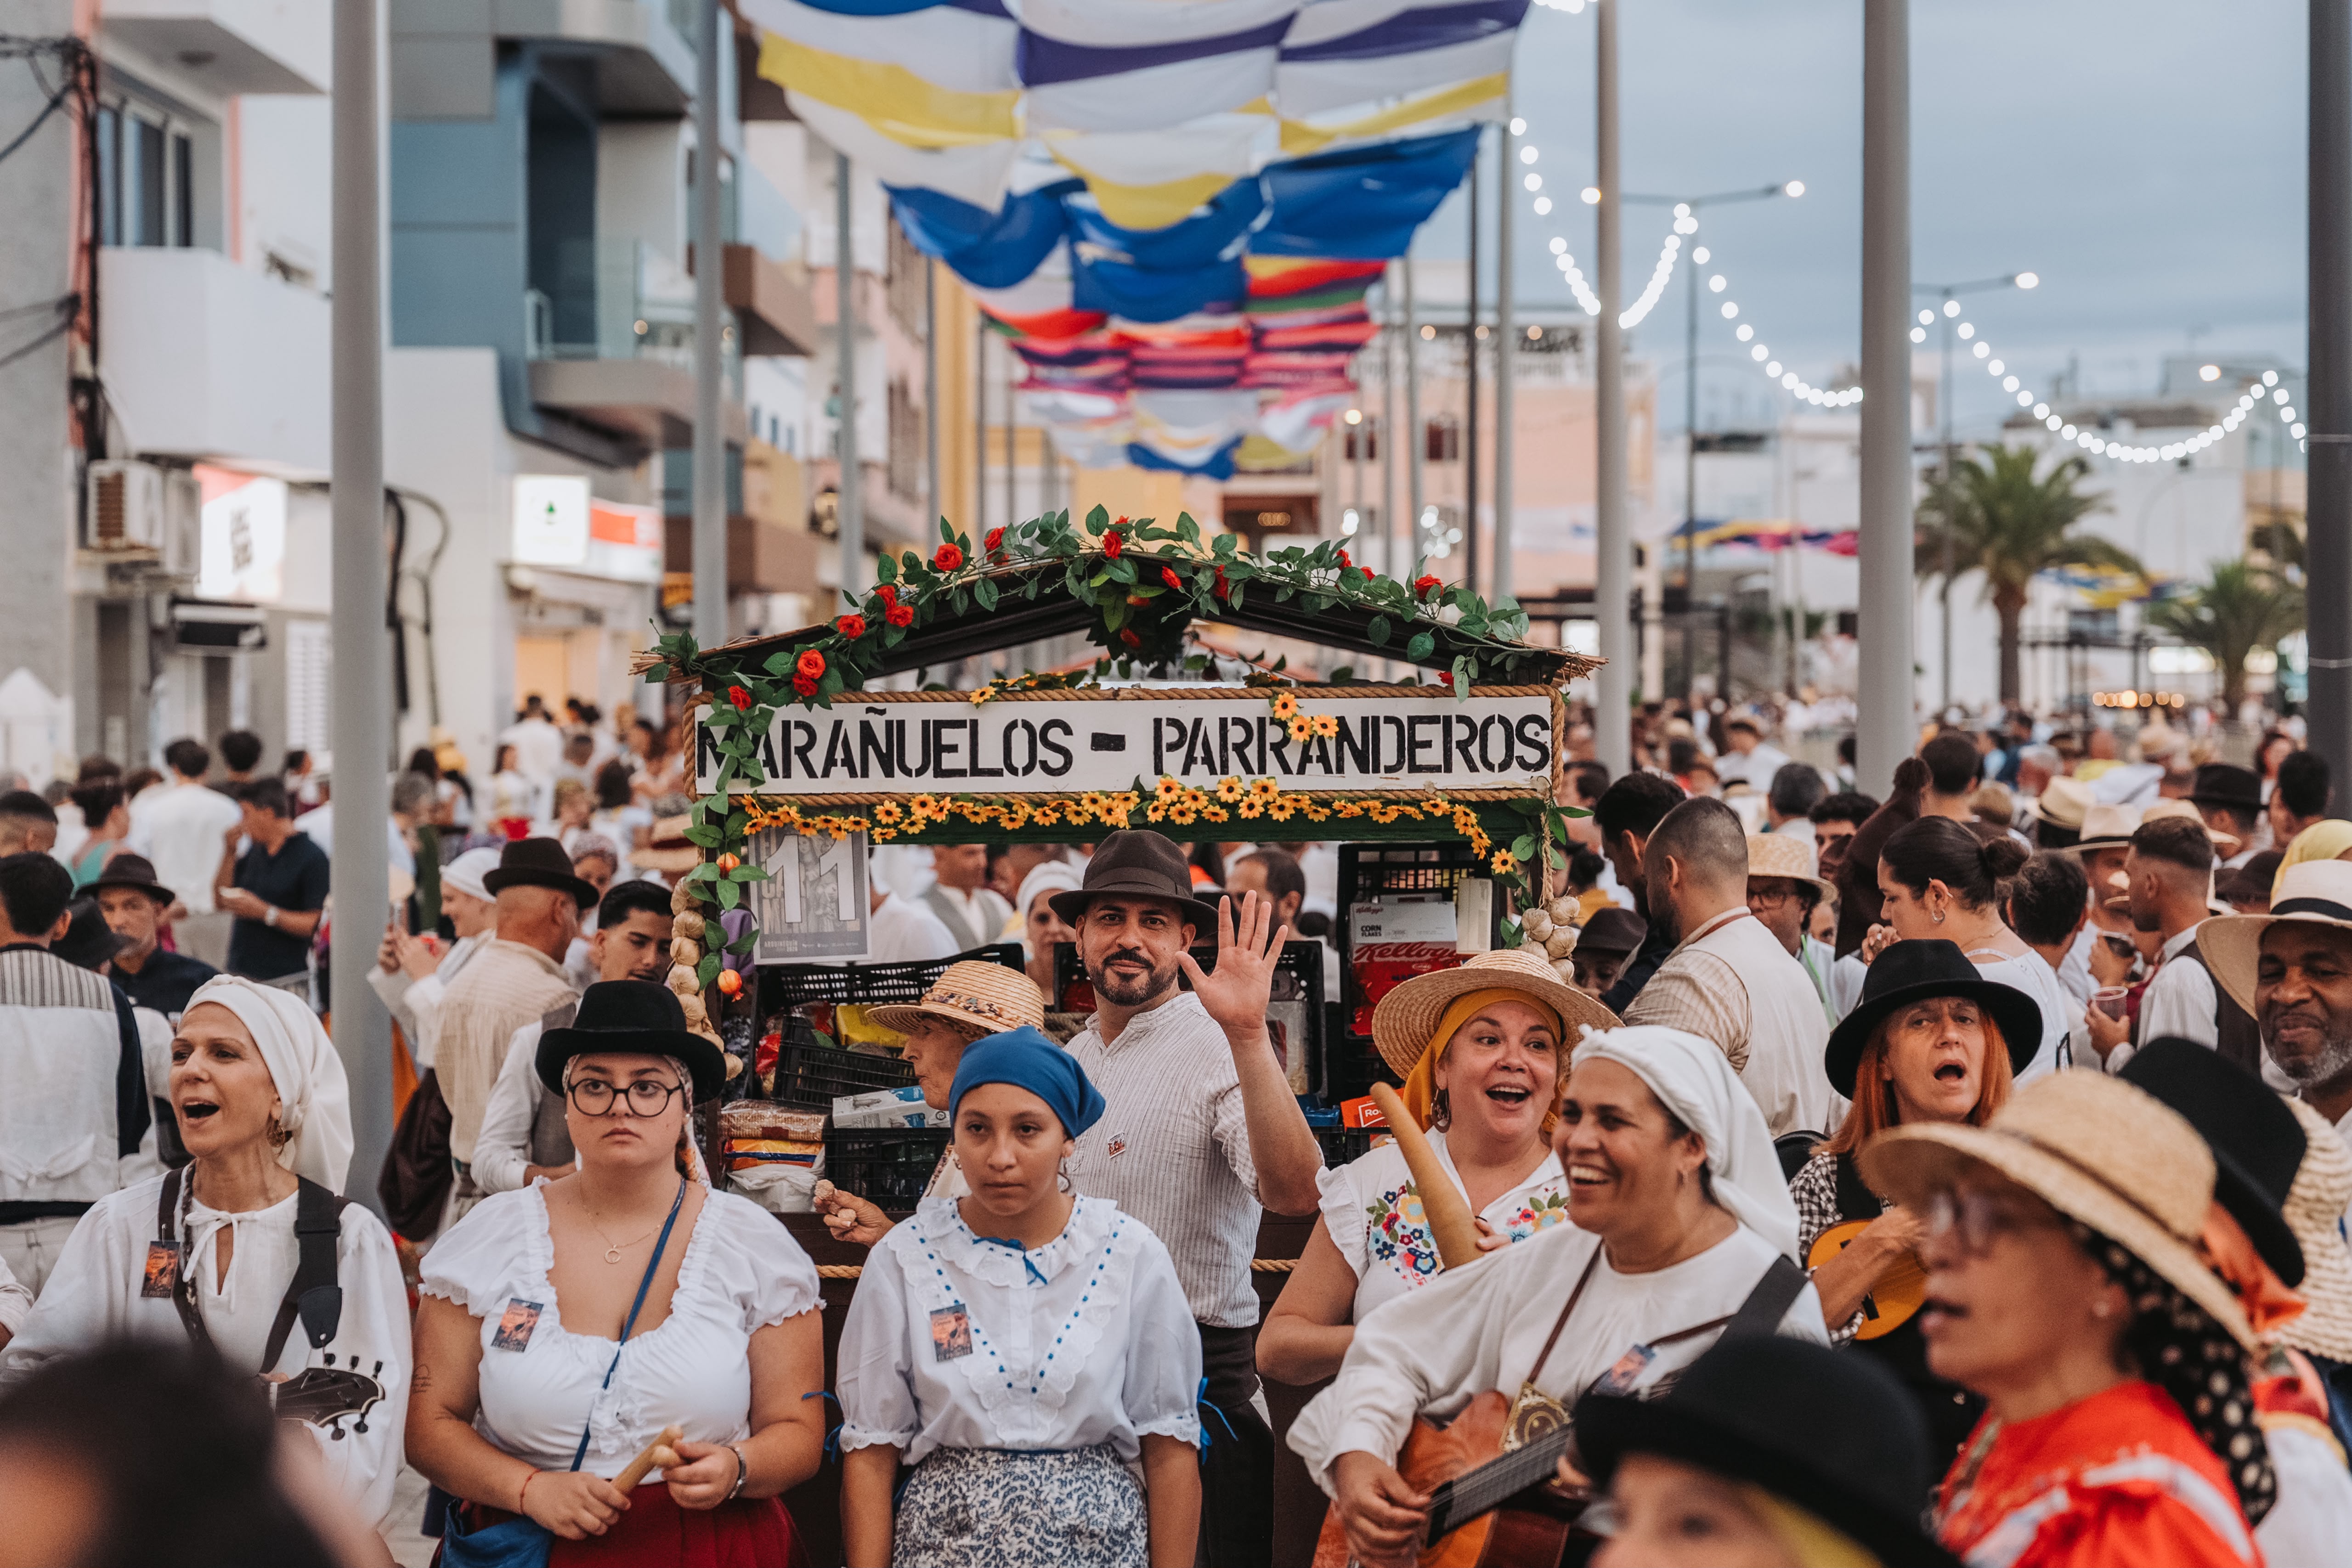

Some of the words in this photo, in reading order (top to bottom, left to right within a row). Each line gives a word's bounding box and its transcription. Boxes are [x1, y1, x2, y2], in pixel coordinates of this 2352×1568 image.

[697, 707, 1073, 778] MARAÑUELOS
[1153, 714, 1550, 775] PARRANDEROS
[766, 832, 856, 923] 11
